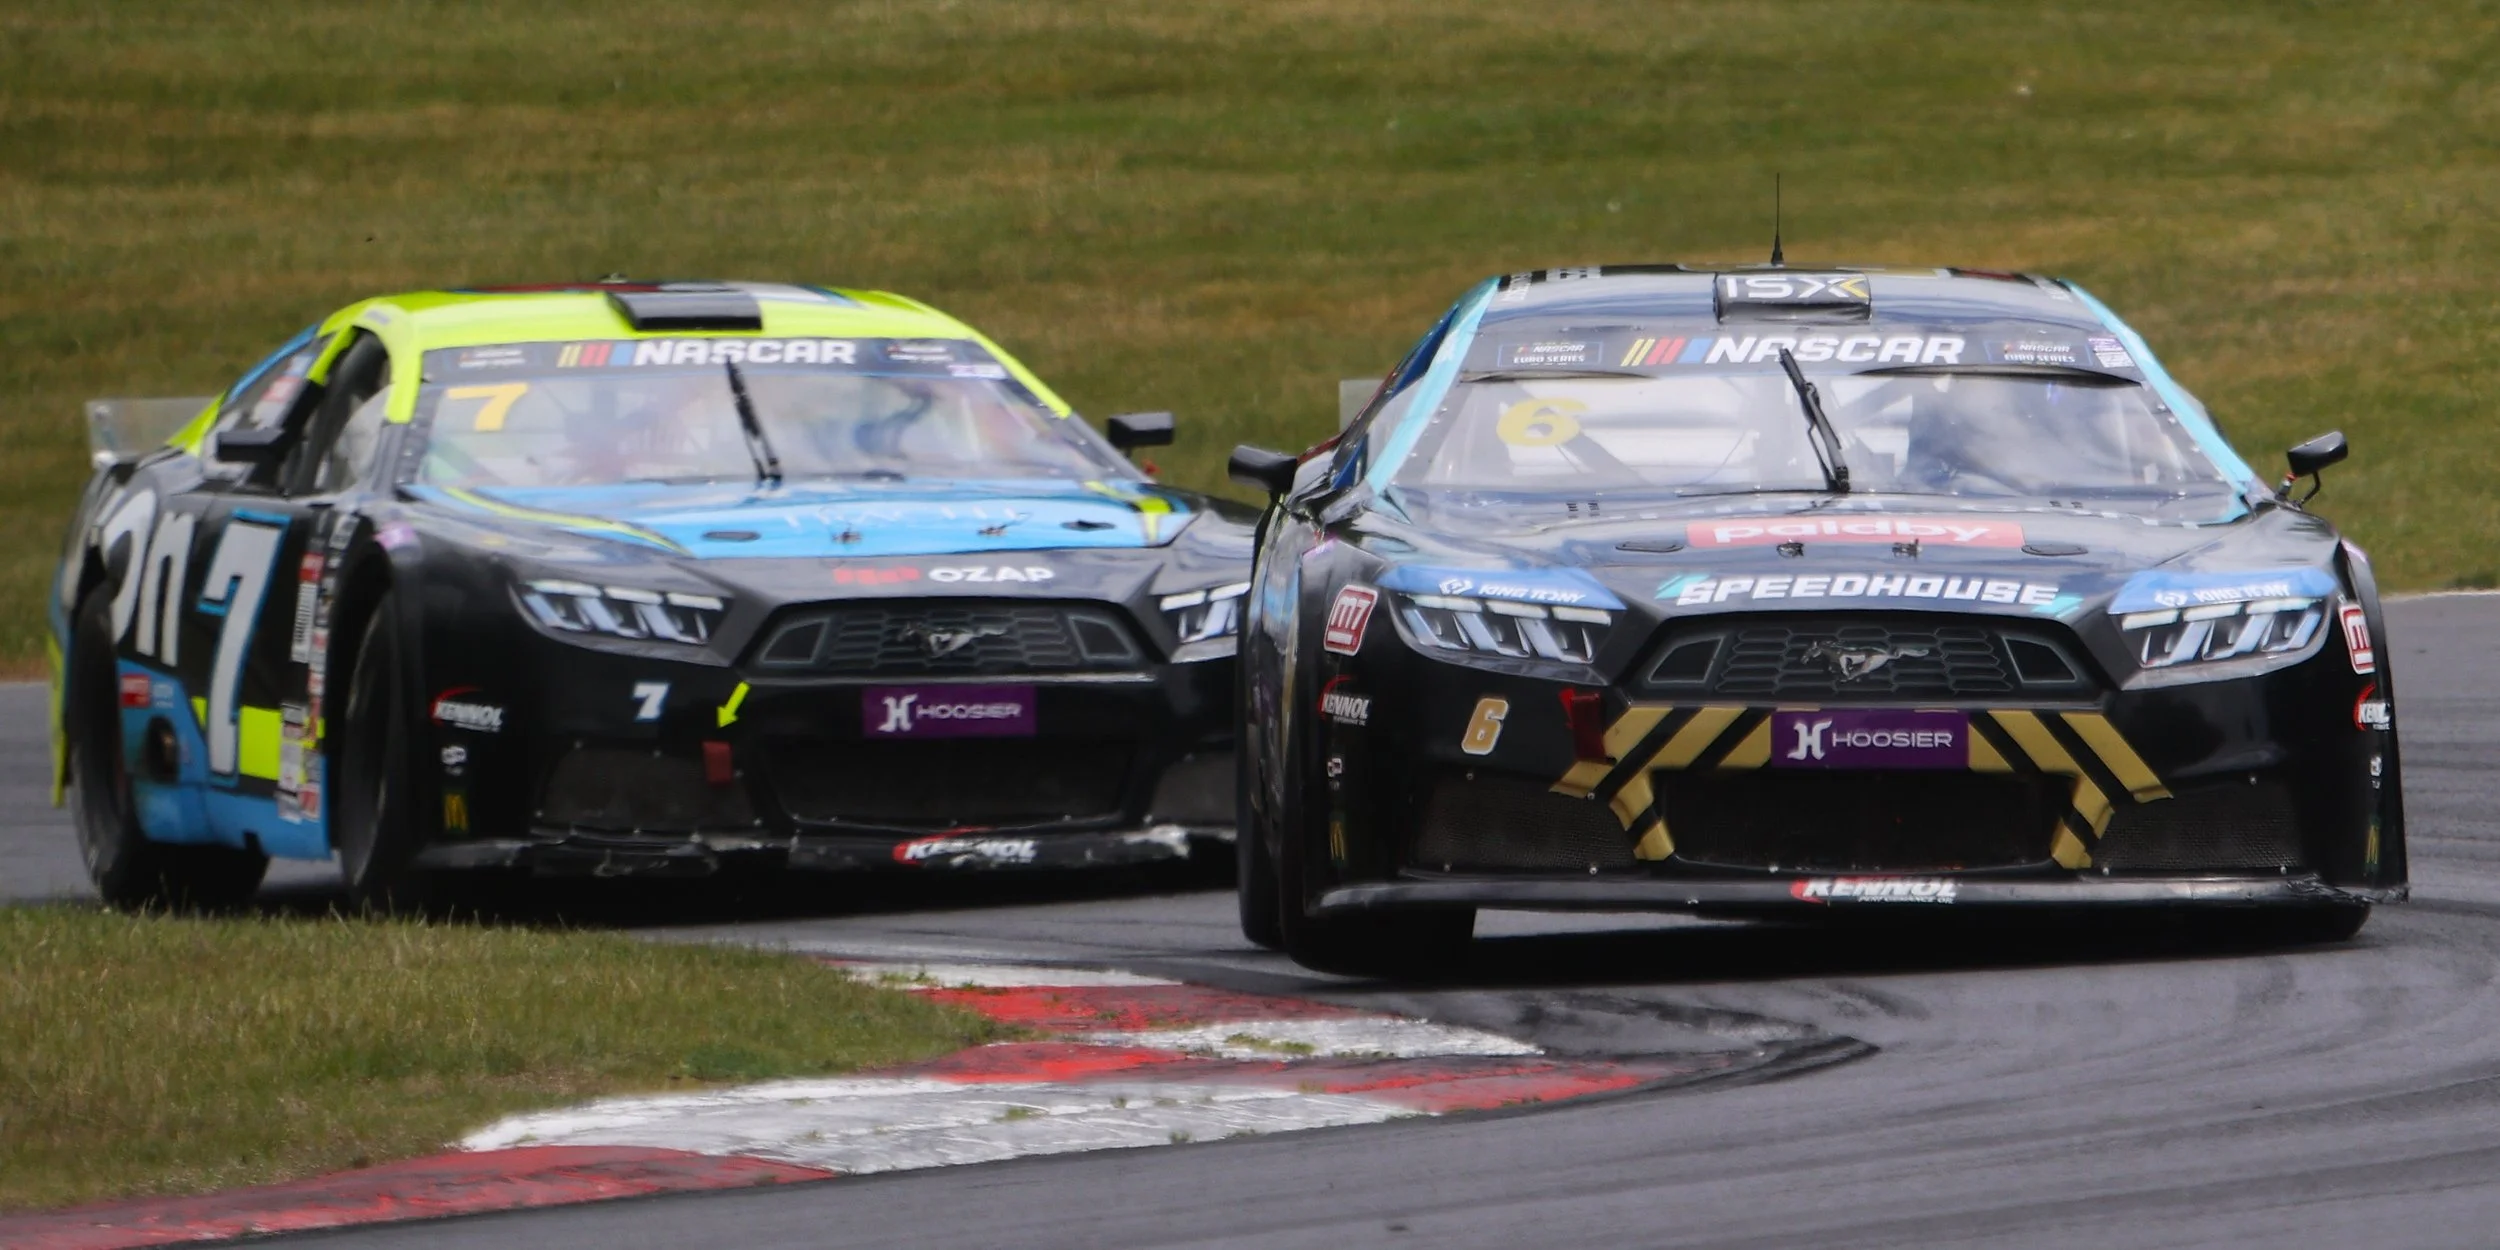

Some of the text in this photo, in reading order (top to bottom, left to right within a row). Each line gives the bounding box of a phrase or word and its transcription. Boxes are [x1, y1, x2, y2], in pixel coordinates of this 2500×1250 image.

[633, 339, 857, 366] NASCAR
[1513, 354, 1585, 364] EURO SERIES
[1533, 343, 1585, 353] NASCAR
[1704, 335, 1966, 364] NASCAR
[2019, 343, 2071, 353] NASCAR
[447, 381, 529, 432] 7
[1496, 397, 1588, 447] 6
[1713, 520, 1990, 543] paldby
[927, 564, 1056, 584] OZAP
[1478, 584, 1587, 604] KING TONY
[1676, 573, 2061, 606] SPEEDHOUSE
[2193, 582, 2290, 603] KING TONY
[197, 508, 291, 784] 7
[631, 681, 671, 721] 7
[916, 702, 1023, 720] HOOSIER
[1321, 693, 1370, 720] KENNOL
[1460, 697, 1509, 756] 6
[1831, 731, 1954, 748] HOOSIER
[1802, 877, 1957, 898] KENNOL
